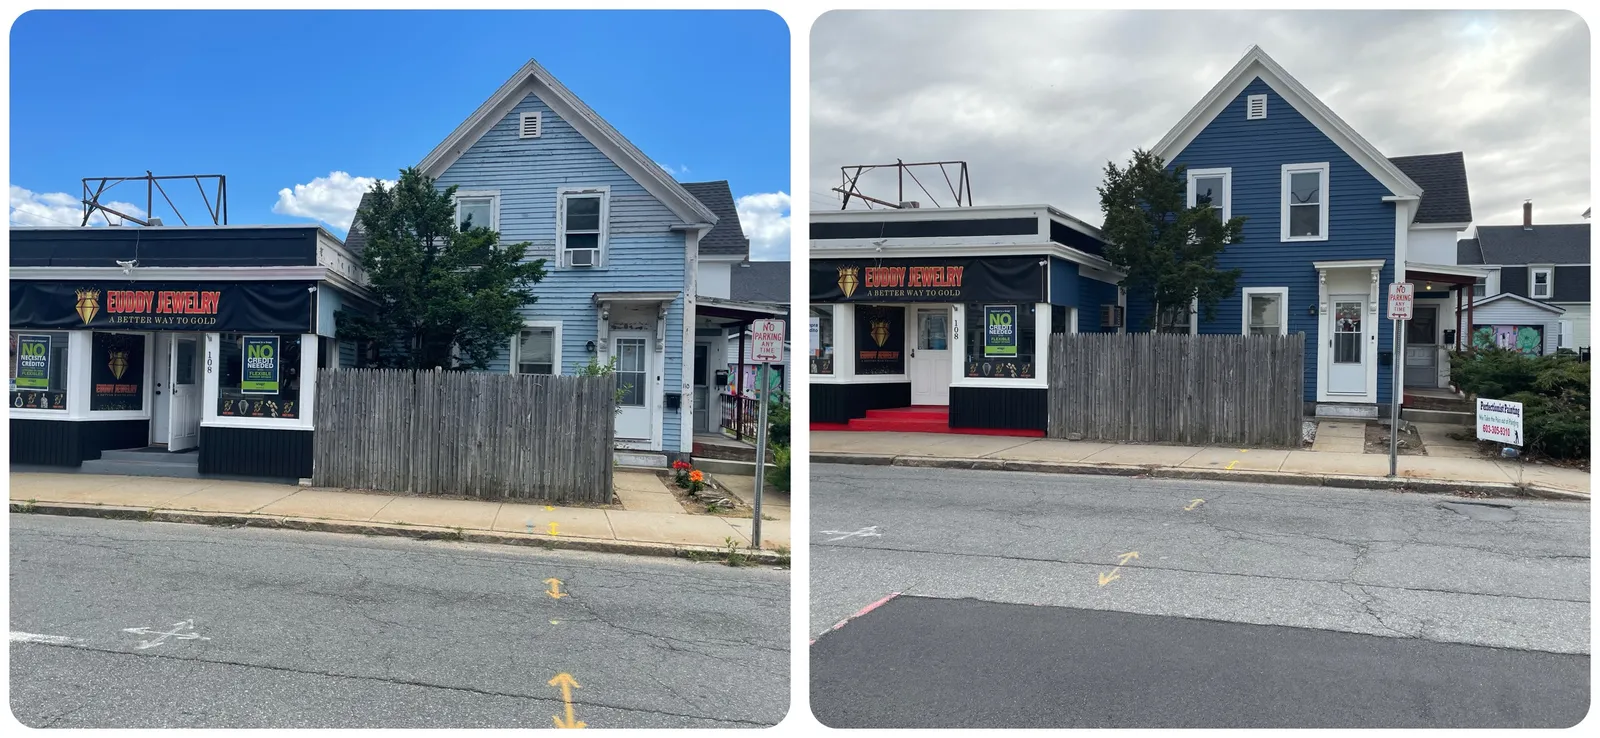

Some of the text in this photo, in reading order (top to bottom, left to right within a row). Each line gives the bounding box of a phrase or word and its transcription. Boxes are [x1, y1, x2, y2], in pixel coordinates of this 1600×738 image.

[865, 266, 963, 287] EUDDY JEWELRY
[107, 290, 220, 314] EUDDY JEWELRY
[989, 313, 1012, 325] NO
[763, 323, 774, 331] NO
[755, 333, 782, 341] PARKING
[22, 343, 45, 357] NO
[247, 344, 274, 358] NO
